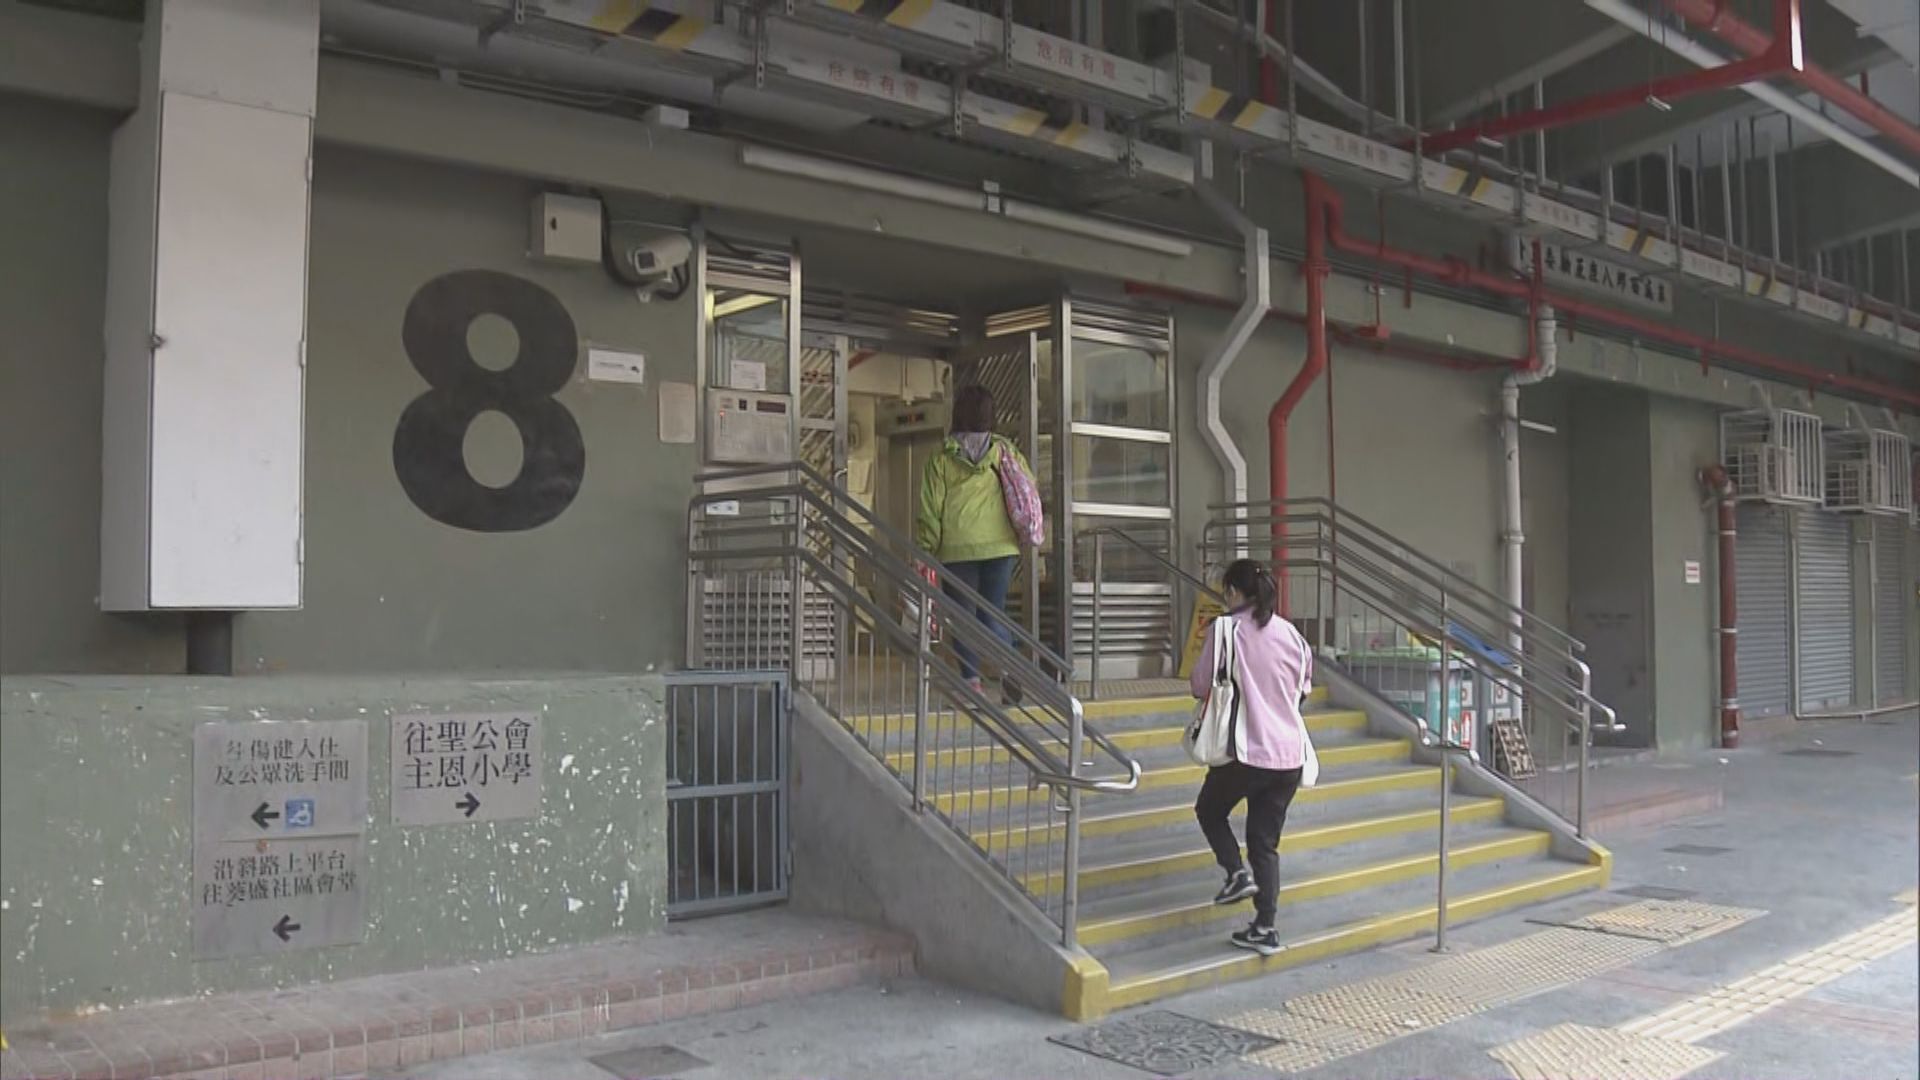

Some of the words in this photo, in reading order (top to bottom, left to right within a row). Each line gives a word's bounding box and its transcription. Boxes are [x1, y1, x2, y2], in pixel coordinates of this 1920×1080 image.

[393, 269, 585, 533] 8
[404, 717, 532, 755] 往聖公會
[215, 760, 349, 785] 及公眾洗手間
[401, 752, 532, 789] 主恩小學
[214, 849, 346, 880] 沿斜路上平台
